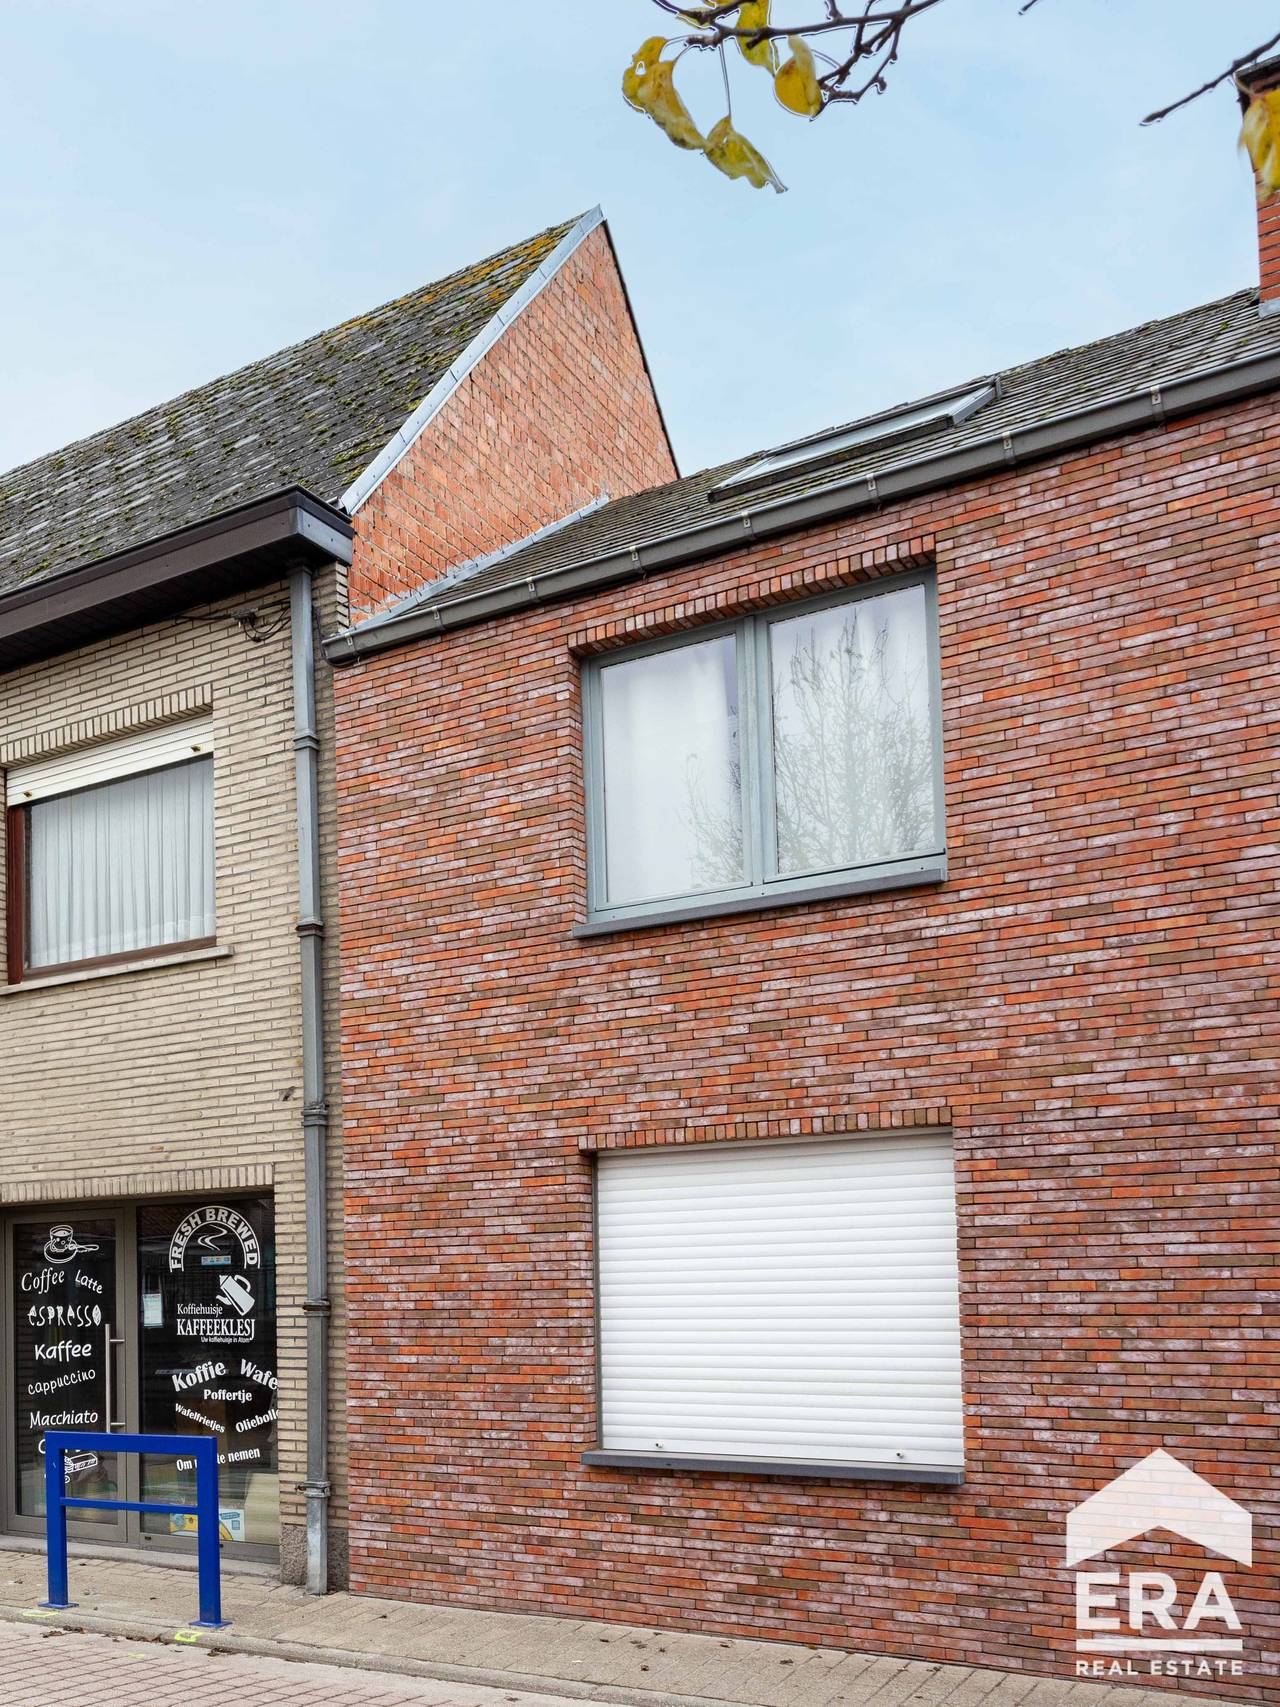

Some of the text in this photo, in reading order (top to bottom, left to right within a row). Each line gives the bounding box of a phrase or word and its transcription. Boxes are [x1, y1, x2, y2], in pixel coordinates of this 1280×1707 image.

[171, 1208, 259, 1270] FRESH BREWED
[21, 1267, 103, 1295] Coffee Latte
[176, 1303, 223, 1318] Koffiehuisje
[176, 1318, 256, 1341] KAFFEEKLESJ
[34, 1340, 92, 1362] Kaffee
[27, 1369, 96, 1395] cappuccino
[171, 1360, 226, 1392] Koffie
[203, 1388, 253, 1403] Poffertje
[29, 1410, 99, 1428] Macchiato
[174, 1403, 226, 1434] Wafelfrietjes
[176, 1459, 193, 1471] Om
[228, 1447, 261, 1462] nemen
